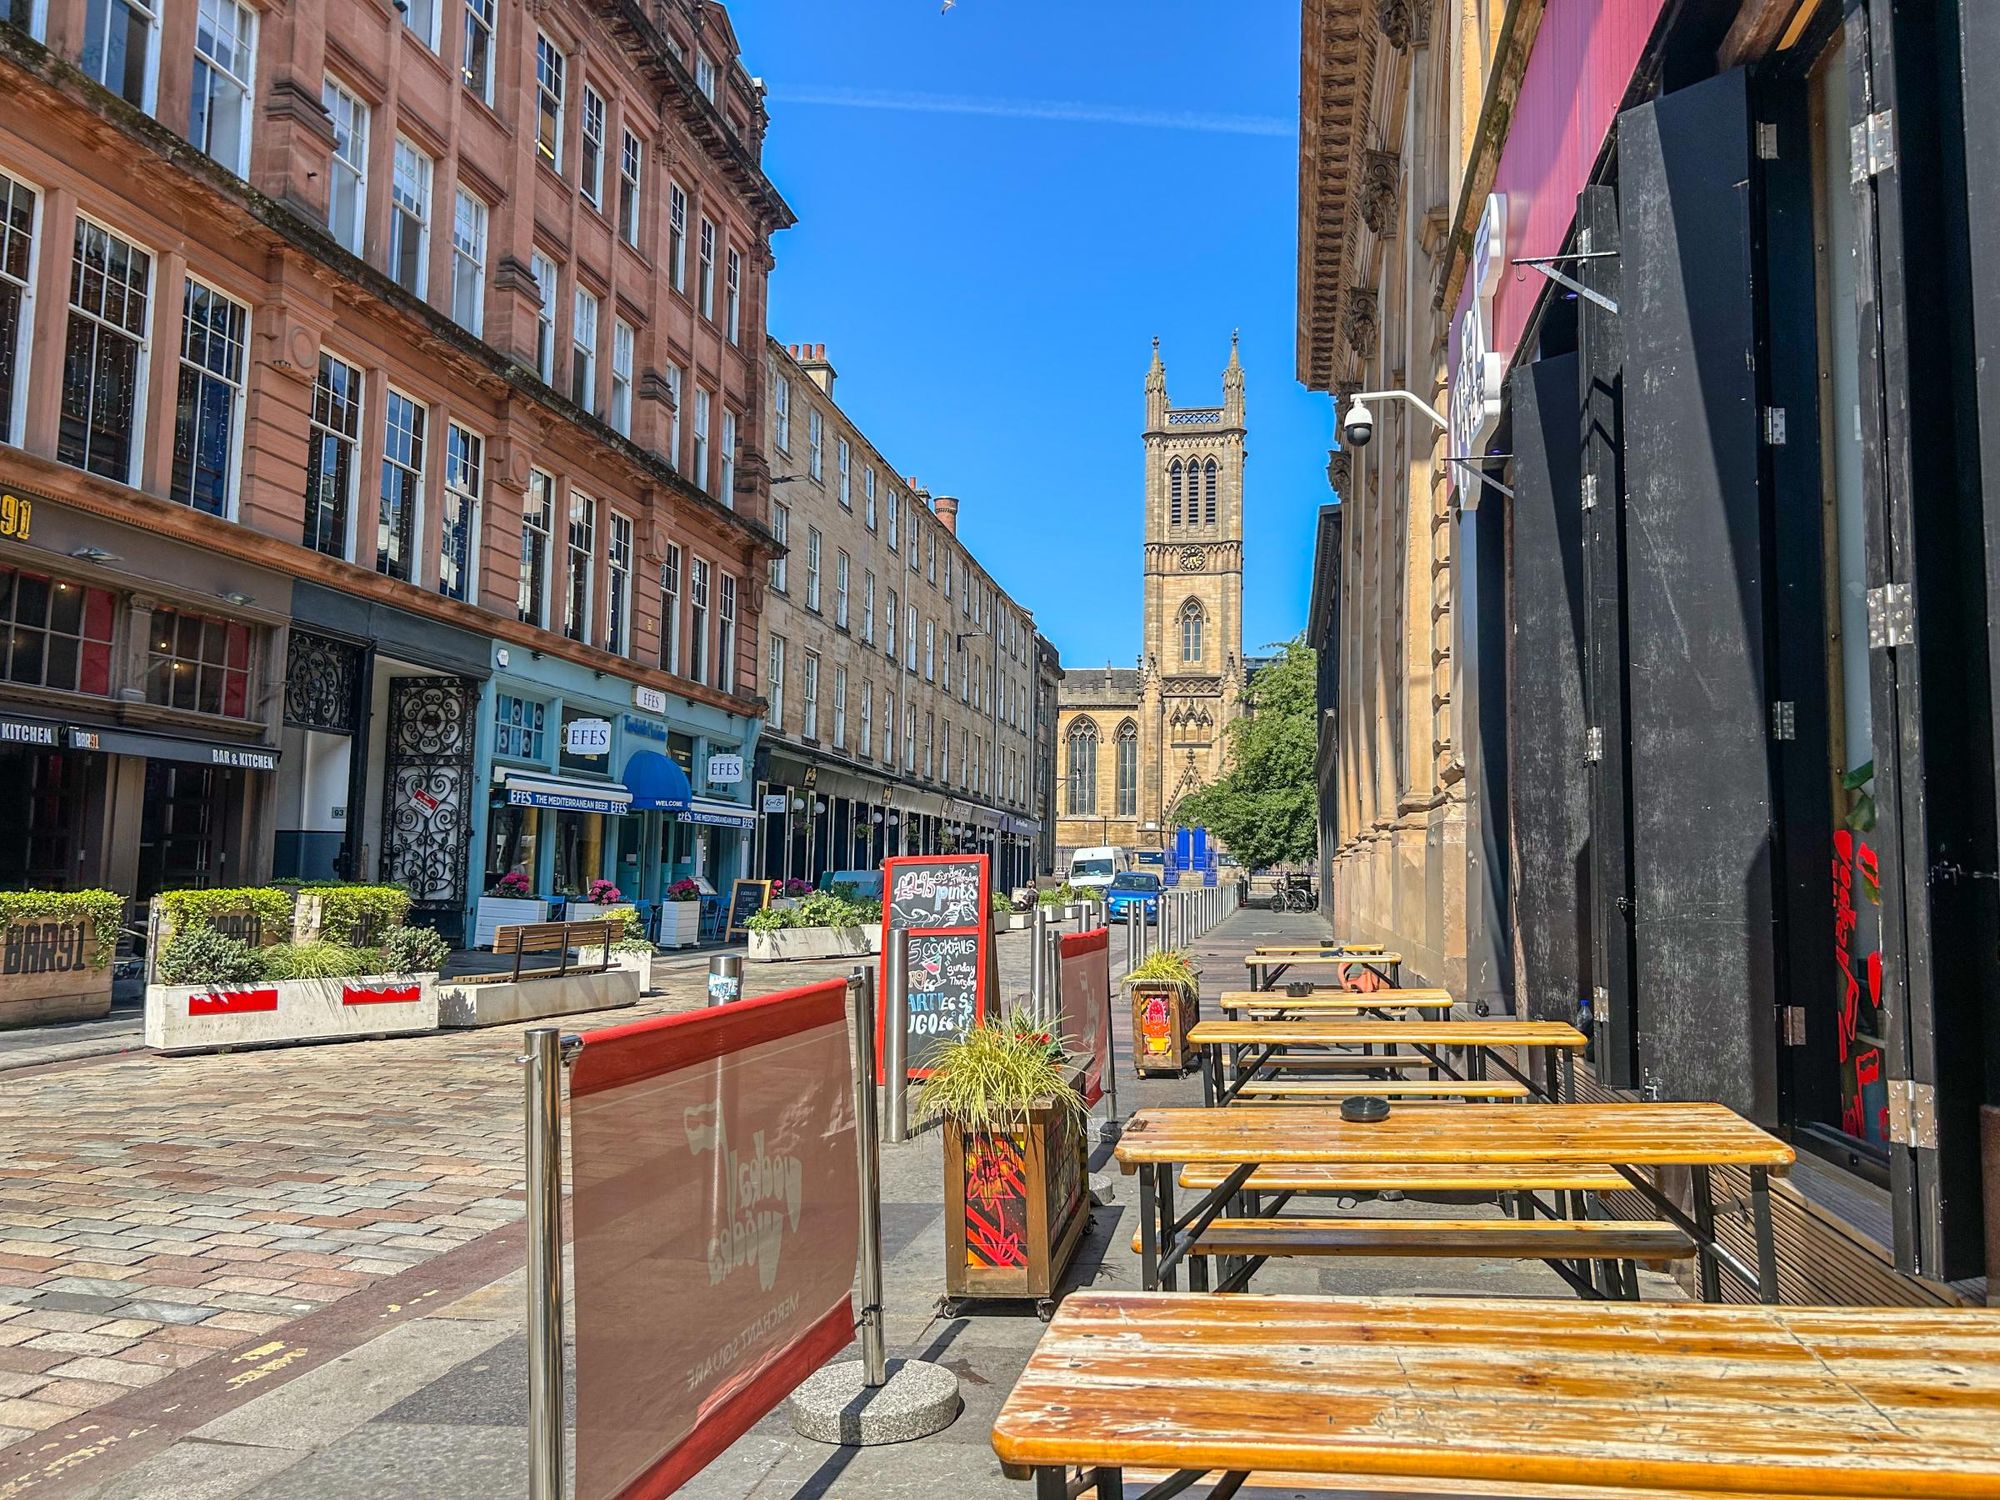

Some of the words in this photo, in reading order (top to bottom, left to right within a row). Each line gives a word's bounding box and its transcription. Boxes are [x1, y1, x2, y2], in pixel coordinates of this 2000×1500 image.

[643, 692, 660, 709] EFES
[1, 722, 52, 744] KITCHEN
[75, 731, 99, 750] BAR91
[571, 729, 607, 746] EFES
[212, 749, 230, 764] BAR
[231, 753, 238, 765] &
[239, 752, 273, 770] KITCHEN
[711, 762, 740, 776] EFES
[510, 789, 532, 805] EFES
[536, 794, 548, 805] THE
[548, 796, 594, 810] MEDITERRANEAN
[595, 801, 608, 811] BEER
[610, 801, 628, 814] EFES
[334, 809, 344, 817] 93
[3, 921, 85, 974] BAR91
